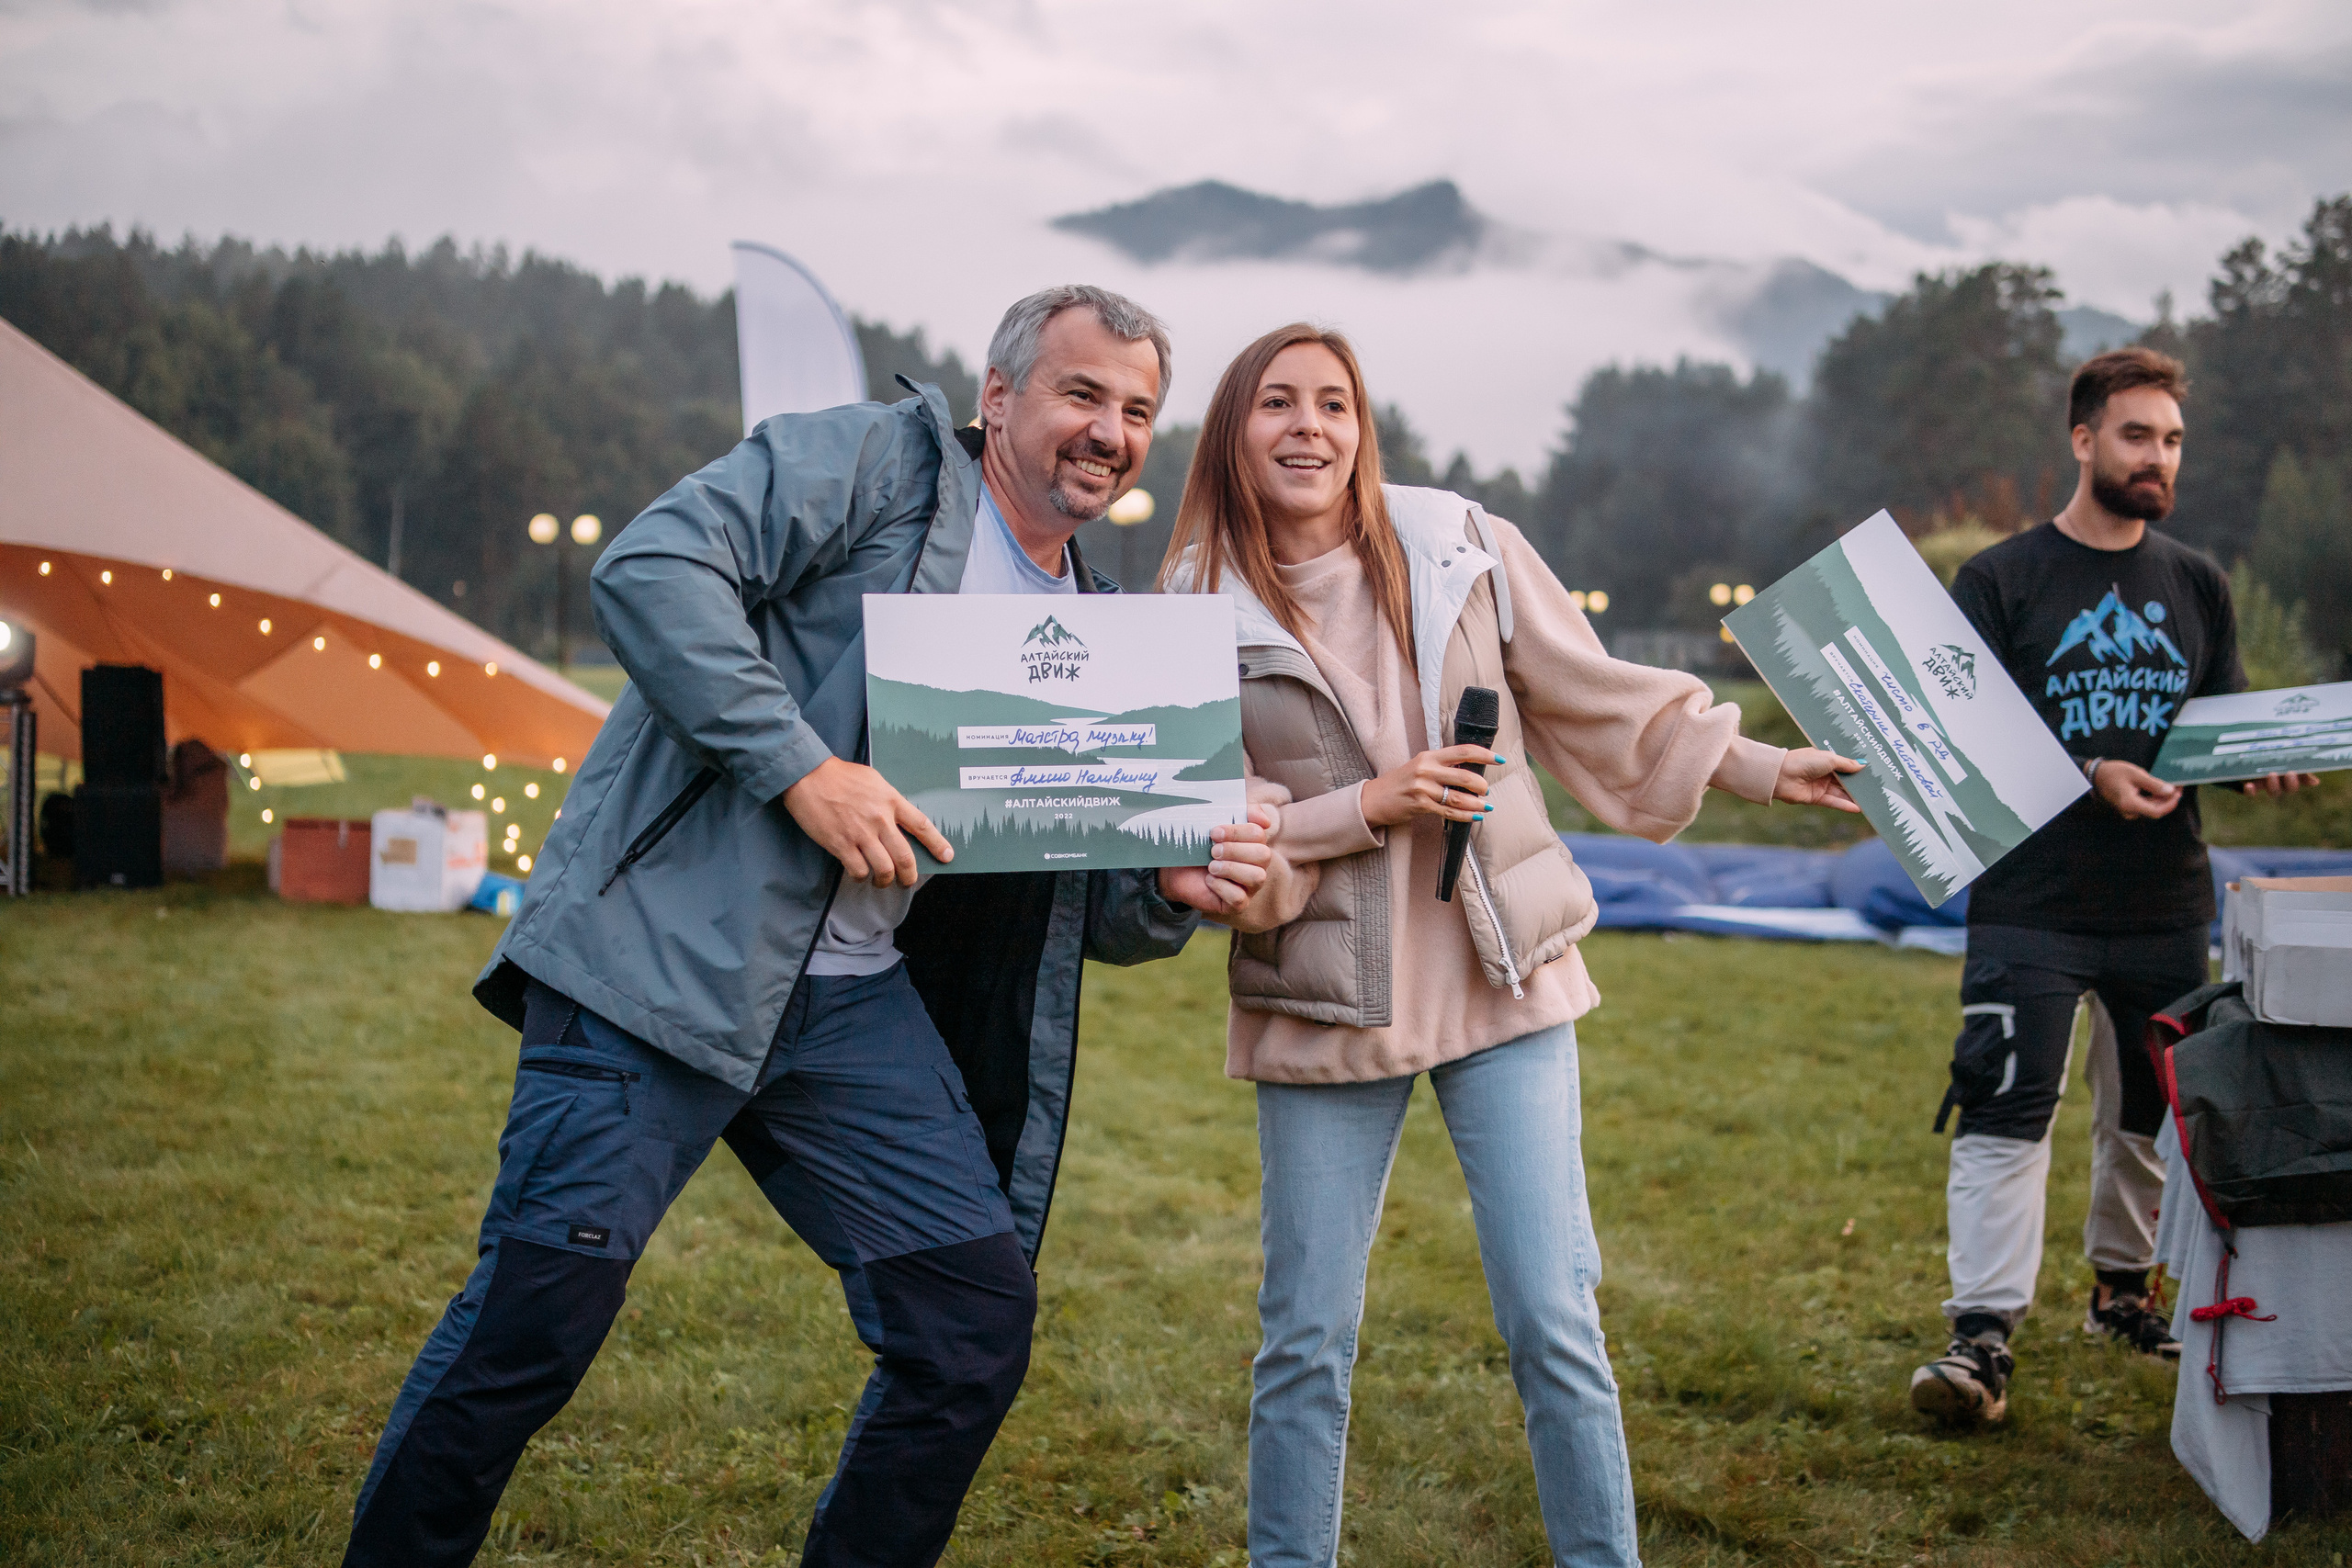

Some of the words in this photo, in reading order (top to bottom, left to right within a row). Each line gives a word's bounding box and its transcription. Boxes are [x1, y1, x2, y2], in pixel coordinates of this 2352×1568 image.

[1020, 649, 1090, 662] АЛТАЙСКИЙ
[1853, 635, 1879, 669] НОМИНАЦИЯ
[1027, 662, 1081, 683] ДВИЖ
[1922, 656, 1961, 700] ДВИЖ
[1929, 647, 1974, 701] АЛТАЙСКИЙ
[2045, 663, 2189, 698] АЛТАЙСКИЙ
[2059, 690, 2175, 741] ДВИЖ
[1832, 689, 1905, 782] #АЛТАЙСКИЙДВИЖ
[1853, 732, 1867, 750] 2022
[1004, 795, 1122, 808] #АЛТАЙСКИЙДВИЖ
[578, 1231, 602, 1240] FORCLAZ
